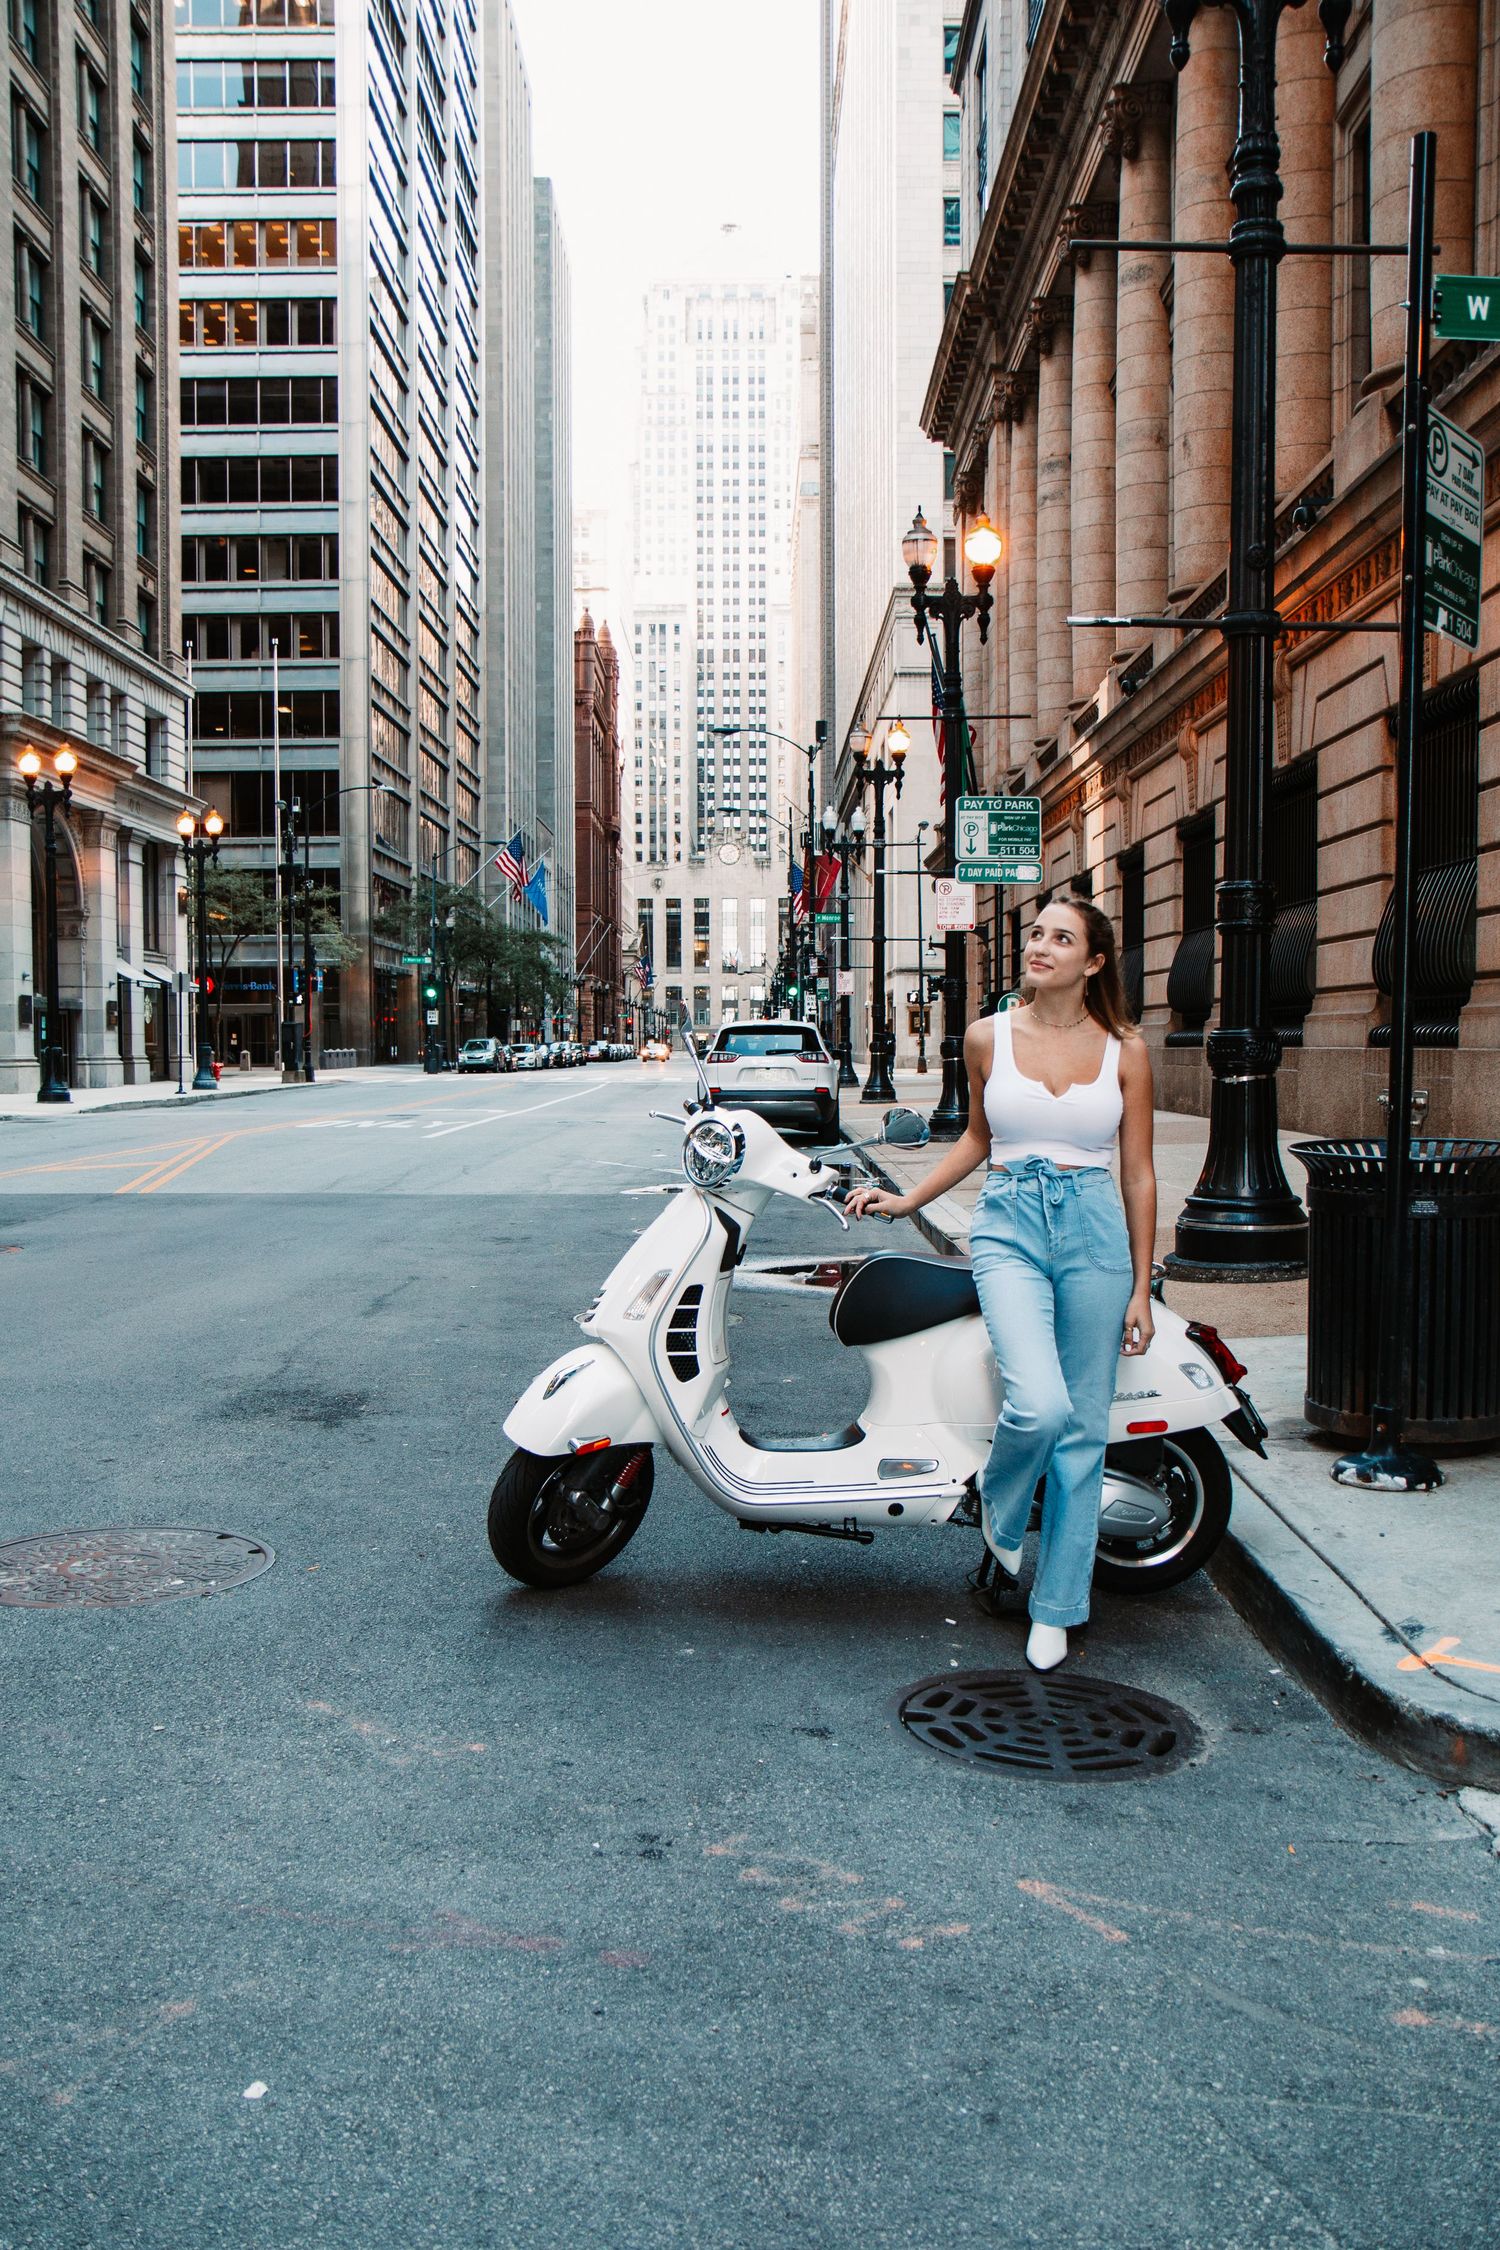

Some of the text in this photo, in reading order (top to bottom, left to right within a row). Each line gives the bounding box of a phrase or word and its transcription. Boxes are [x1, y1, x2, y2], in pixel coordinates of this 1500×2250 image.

[1468, 296, 1490, 321] W
[1458, 463, 1474, 484] 7 DAY
[1426, 483, 1479, 528] PAY AT PAY BOX
[1434, 548, 1476, 591] ParkChicago
[1456, 617, 1472, 642] 504
[963, 800, 1034, 810] PAY TO PARK
[997, 824, 1038, 834] ParkChicago
[1000, 847, 1016, 855] 511
[1019, 847, 1036, 855] 504
[960, 868, 966, 877] 7
[967, 868, 983, 877] DAY
[985, 868, 1003, 877] PAID
[250, 981, 277, 991] Bank
